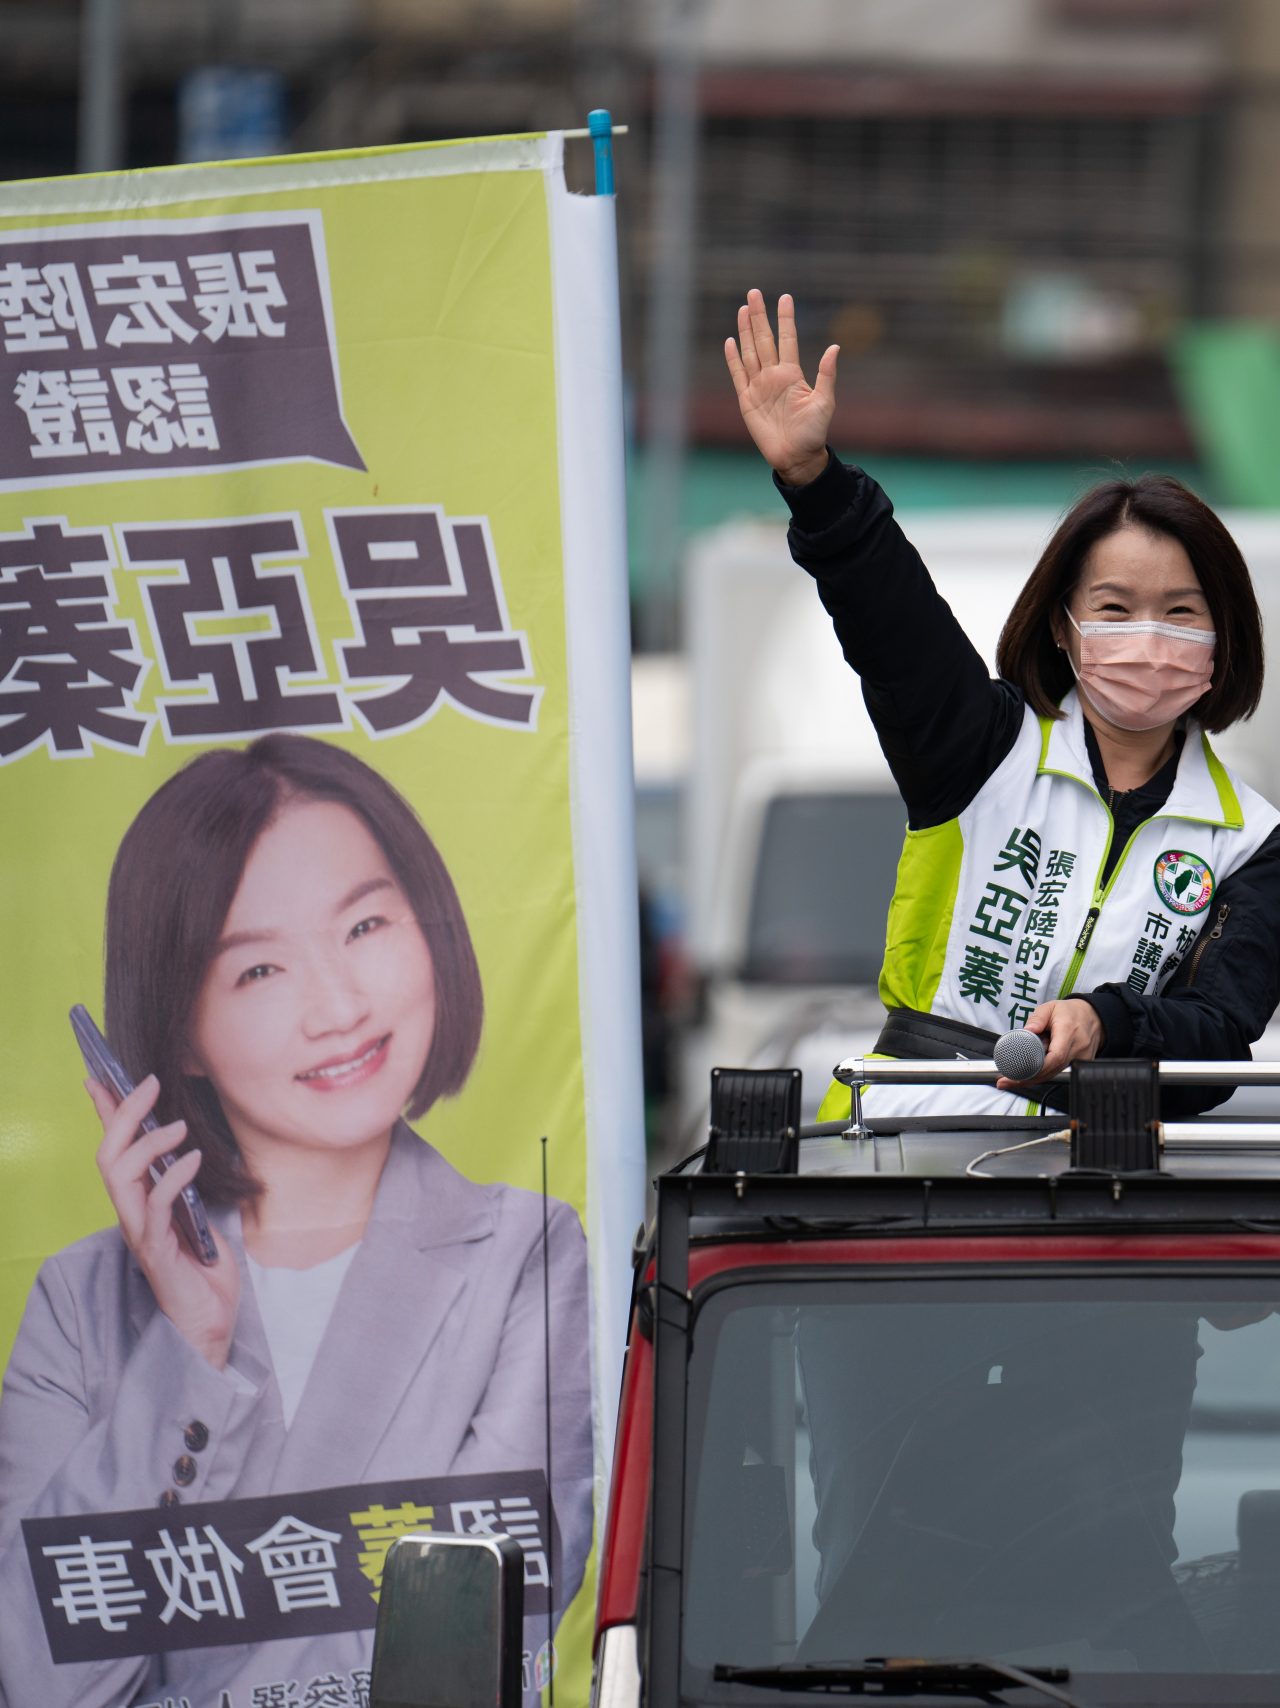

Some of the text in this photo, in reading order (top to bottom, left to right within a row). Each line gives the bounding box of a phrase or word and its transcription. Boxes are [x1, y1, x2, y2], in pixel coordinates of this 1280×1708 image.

[958, 826, 1042, 1008] 吳亞蓁
[1007, 850, 1077, 1029] 張宏陸的主任
[1126, 911, 1173, 994] 市議員
